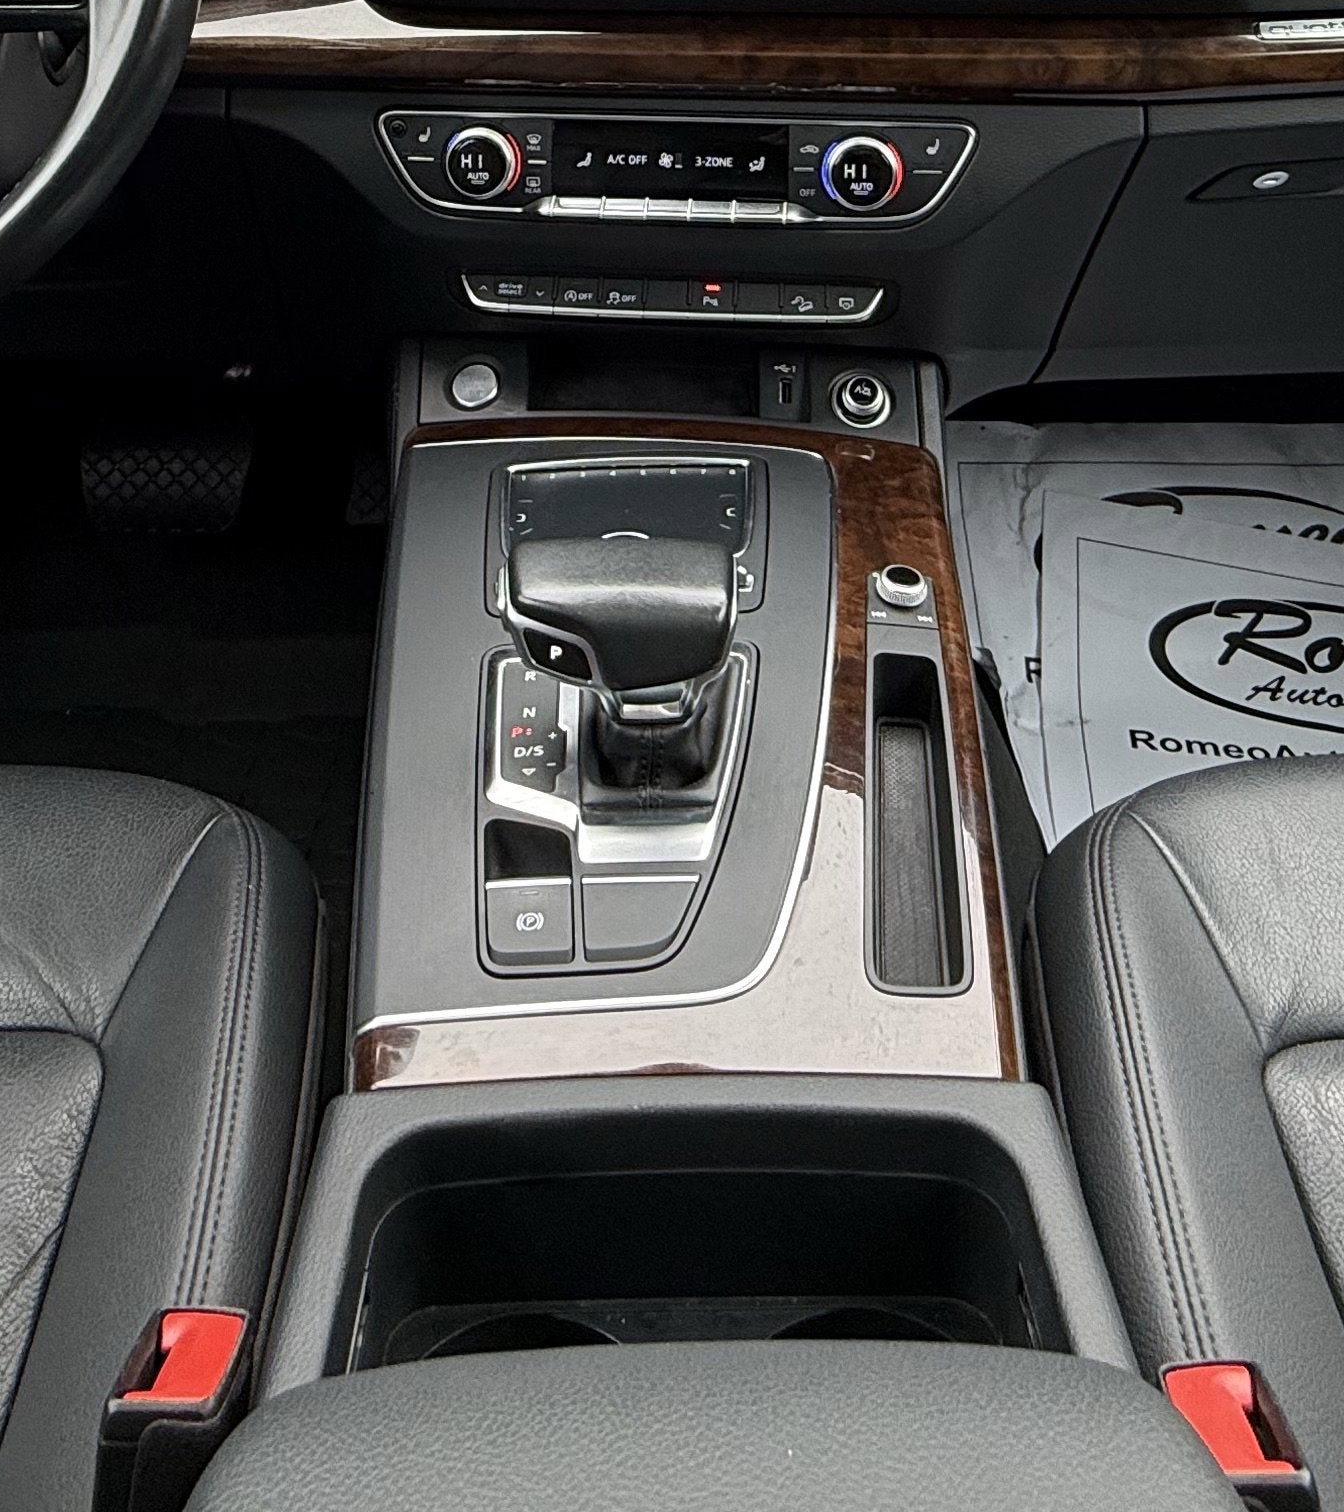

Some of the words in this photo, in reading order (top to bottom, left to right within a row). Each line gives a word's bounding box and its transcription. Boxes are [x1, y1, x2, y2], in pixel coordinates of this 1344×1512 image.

[606, 154, 626, 165] A/C
[628, 155, 648, 166] OFF
[694, 156, 734, 168] 3-ZONE
[466, 171, 490, 181] AUTO
[799, 188, 817, 198] OFF
[849, 182, 874, 192] AUTO
[578, 292, 594, 301] OFF
[621, 294, 637, 303] OFF
[549, 644, 564, 661] P
[524, 670, 537, 682] R
[522, 706, 537, 719] N
[513, 744, 545, 759] D/S
